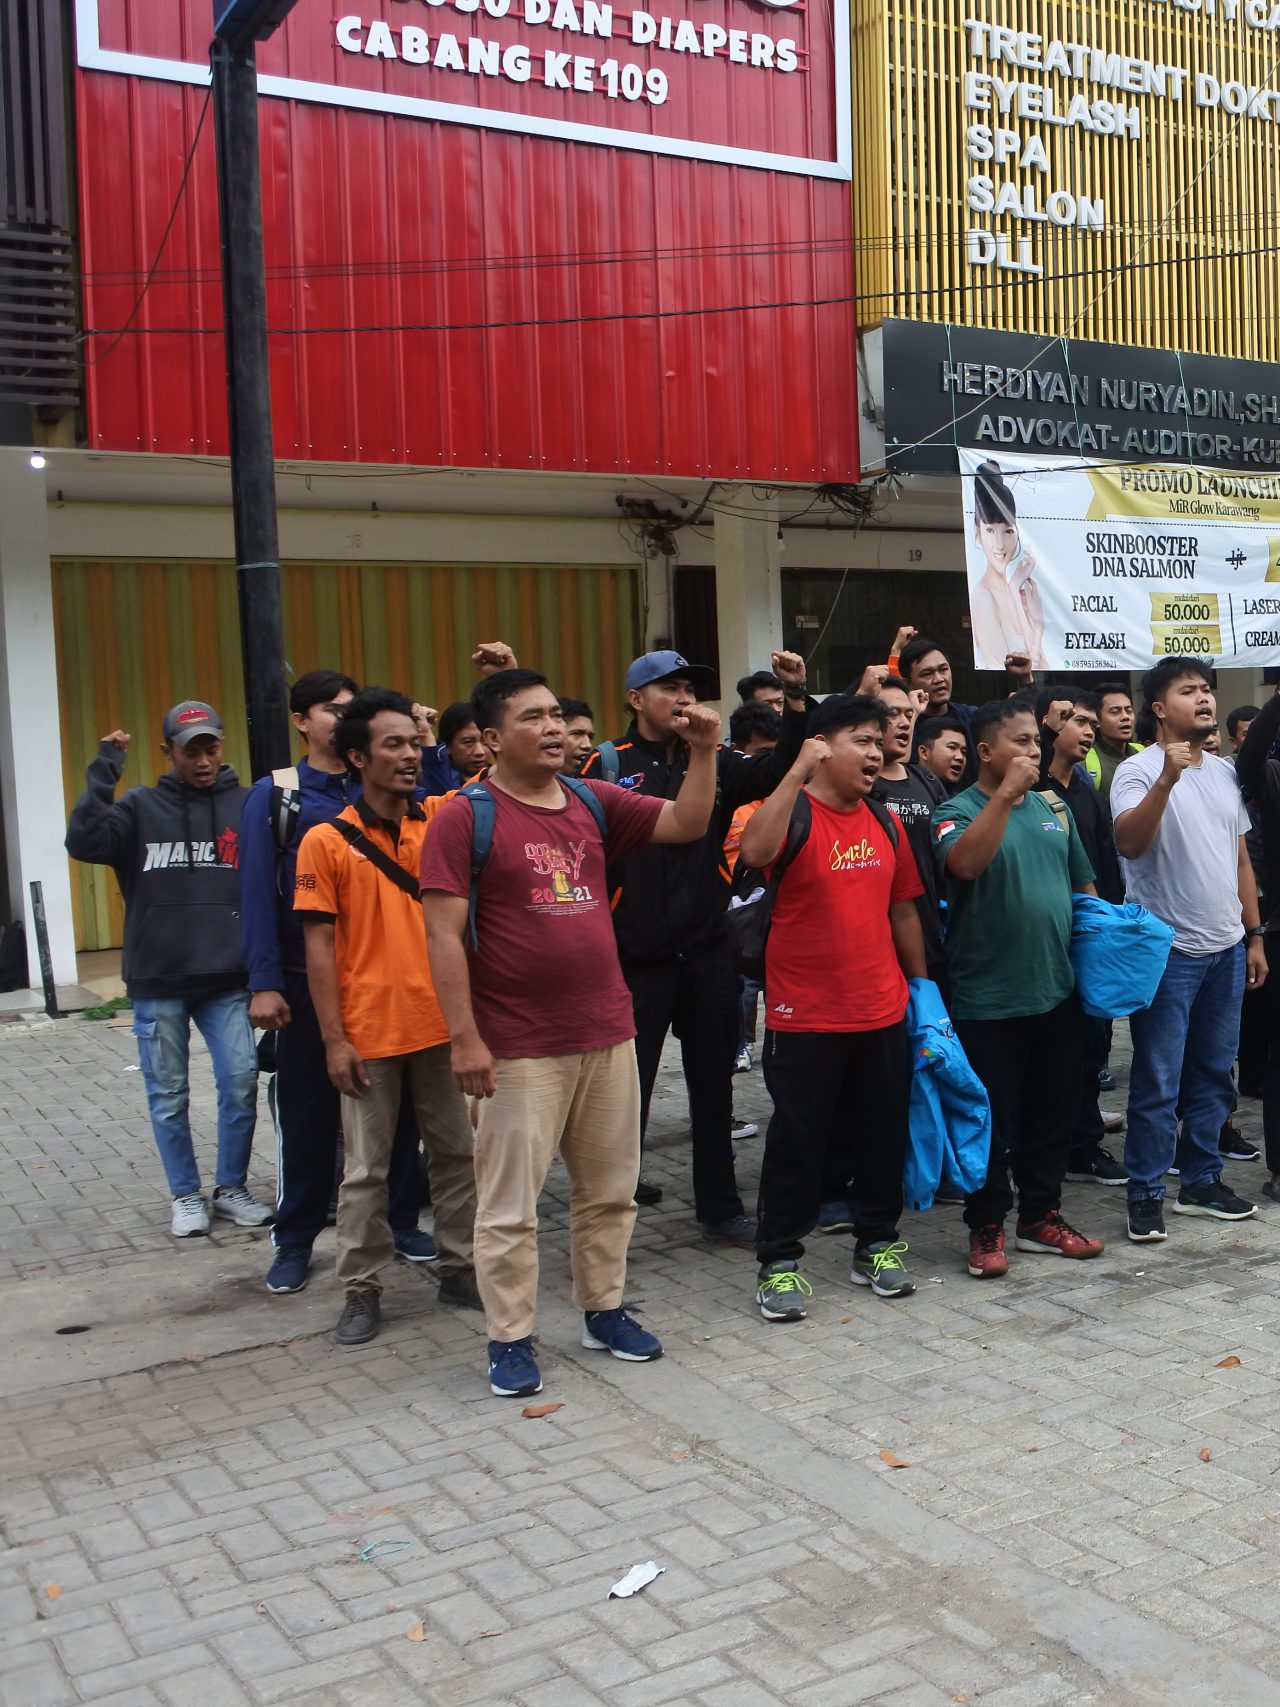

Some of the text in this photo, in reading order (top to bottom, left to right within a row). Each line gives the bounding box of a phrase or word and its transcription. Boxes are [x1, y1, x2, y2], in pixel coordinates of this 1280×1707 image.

[335, 16, 531, 83] CABANG
[524, 0, 799, 73] DAN DIAPERS
[963, 19, 1187, 101] TREATMENT
[964, 71, 1141, 140] EYELASH
[966, 124, 1049, 173] SPA
[966, 174, 1105, 232] SALON
[967, 229, 1044, 274] DLL
[942, 360, 1090, 406] HERDIYAN
[1119, 467, 1192, 495] PROMO
[1191, 501, 1214, 516] Glow
[1215, 502, 1260, 521] Karawang
[1086, 531, 1199, 557] SKINBOOSTER
[1092, 555, 1196, 580] DNA SALMON
[1071, 595, 1118, 613] FACIAL
[1164, 603, 1210, 621] 50.000
[1064, 632, 1127, 650] EYELASH
[829, 838, 877, 871] Smile
